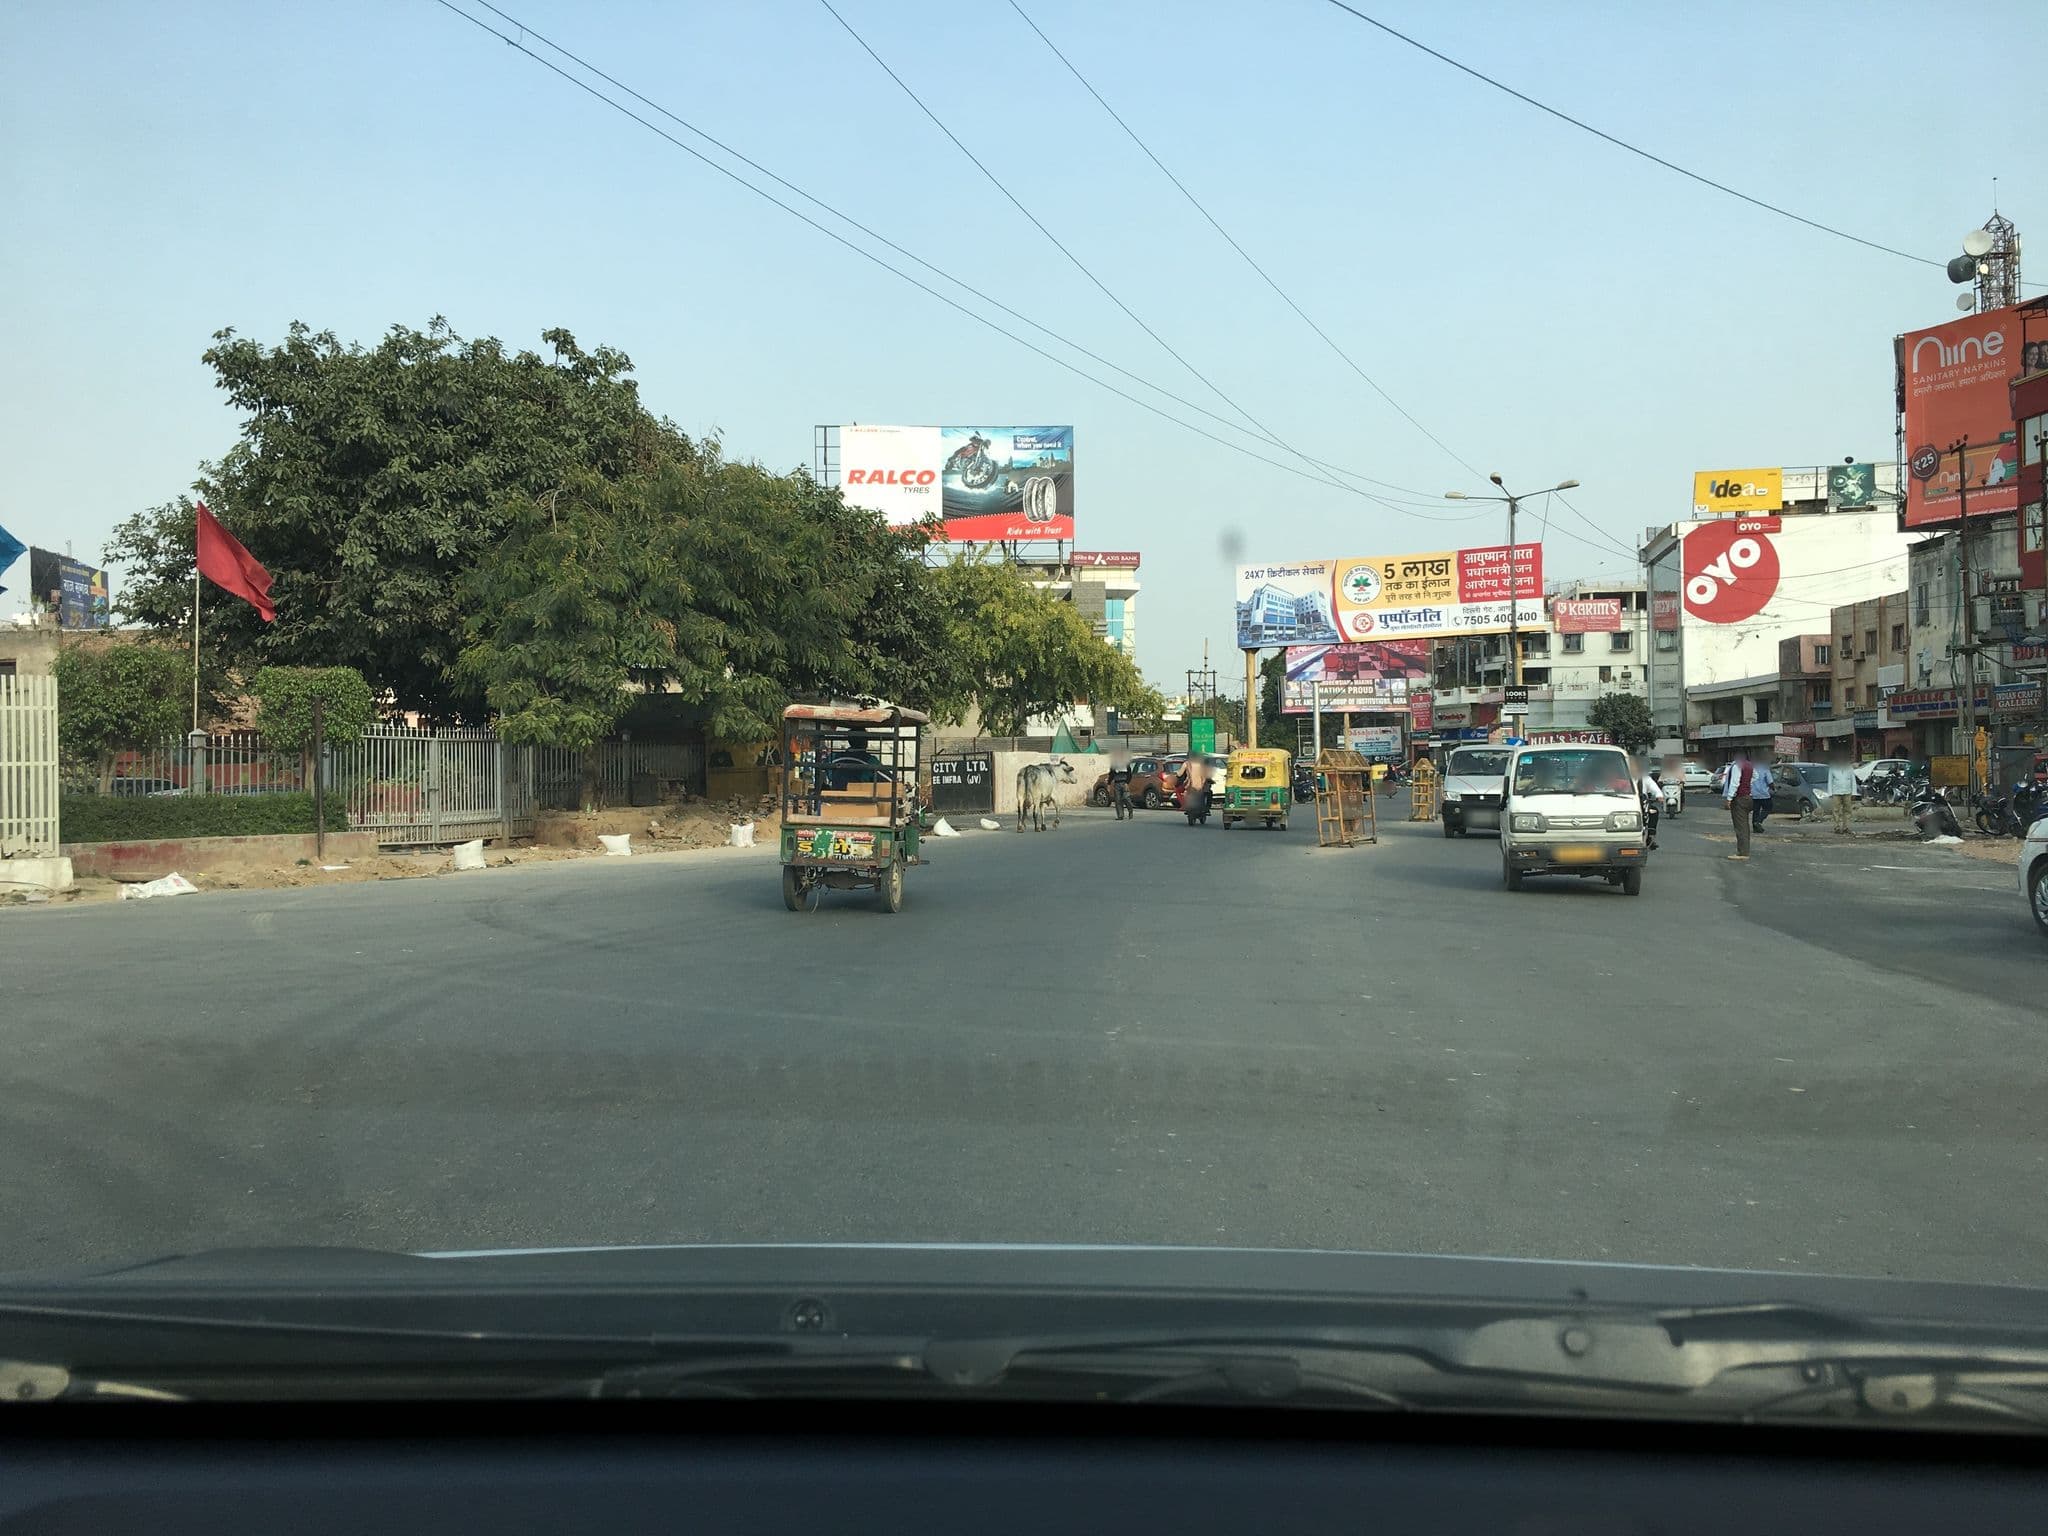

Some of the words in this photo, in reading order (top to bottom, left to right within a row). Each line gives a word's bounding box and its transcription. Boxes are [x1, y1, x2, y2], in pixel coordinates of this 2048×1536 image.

[1913, 369, 1960, 385] SANITARY
[1963, 358, 2006, 374] NAPKINS
[848, 469, 936, 486] RALCO
[903, 486, 930, 494] TYRES
[1006, 526, 1022, 535] Ride
[1025, 527, 1041, 535] with
[1044, 526, 1062, 535] Trust
[1739, 522, 1761, 531] OYO
[1464, 551, 1507, 566] आयुष्मान
[1509, 549, 1533, 560] ारत
[1384, 563, 1395, 579] 5
[1402, 558, 1451, 578] लाख
[1465, 563, 1511, 577] प्रधानमंत्री
[1515, 564, 1532, 574] जन
[1686, 538, 1761, 605] OYO
[1385, 581, 1401, 591] तक
[1405, 580, 1418, 590] का
[1420, 576, 1450, 590] ईलाज
[1465, 577, 1498, 589] आरोग्य
[1464, 614, 1490, 625] 7505
[1517, 612, 1537, 621] 400
[1348, 686, 1373, 694] PROUD
[2018, 690, 2041, 698] CRAFTS
[1998, 698, 2039, 707] GALLERY
[1531, 734, 1565, 745] HILL'S
[933, 762, 957, 773] CITY
[967, 760, 988, 772] LTD.
[967, 774, 981, 785] (JV)
